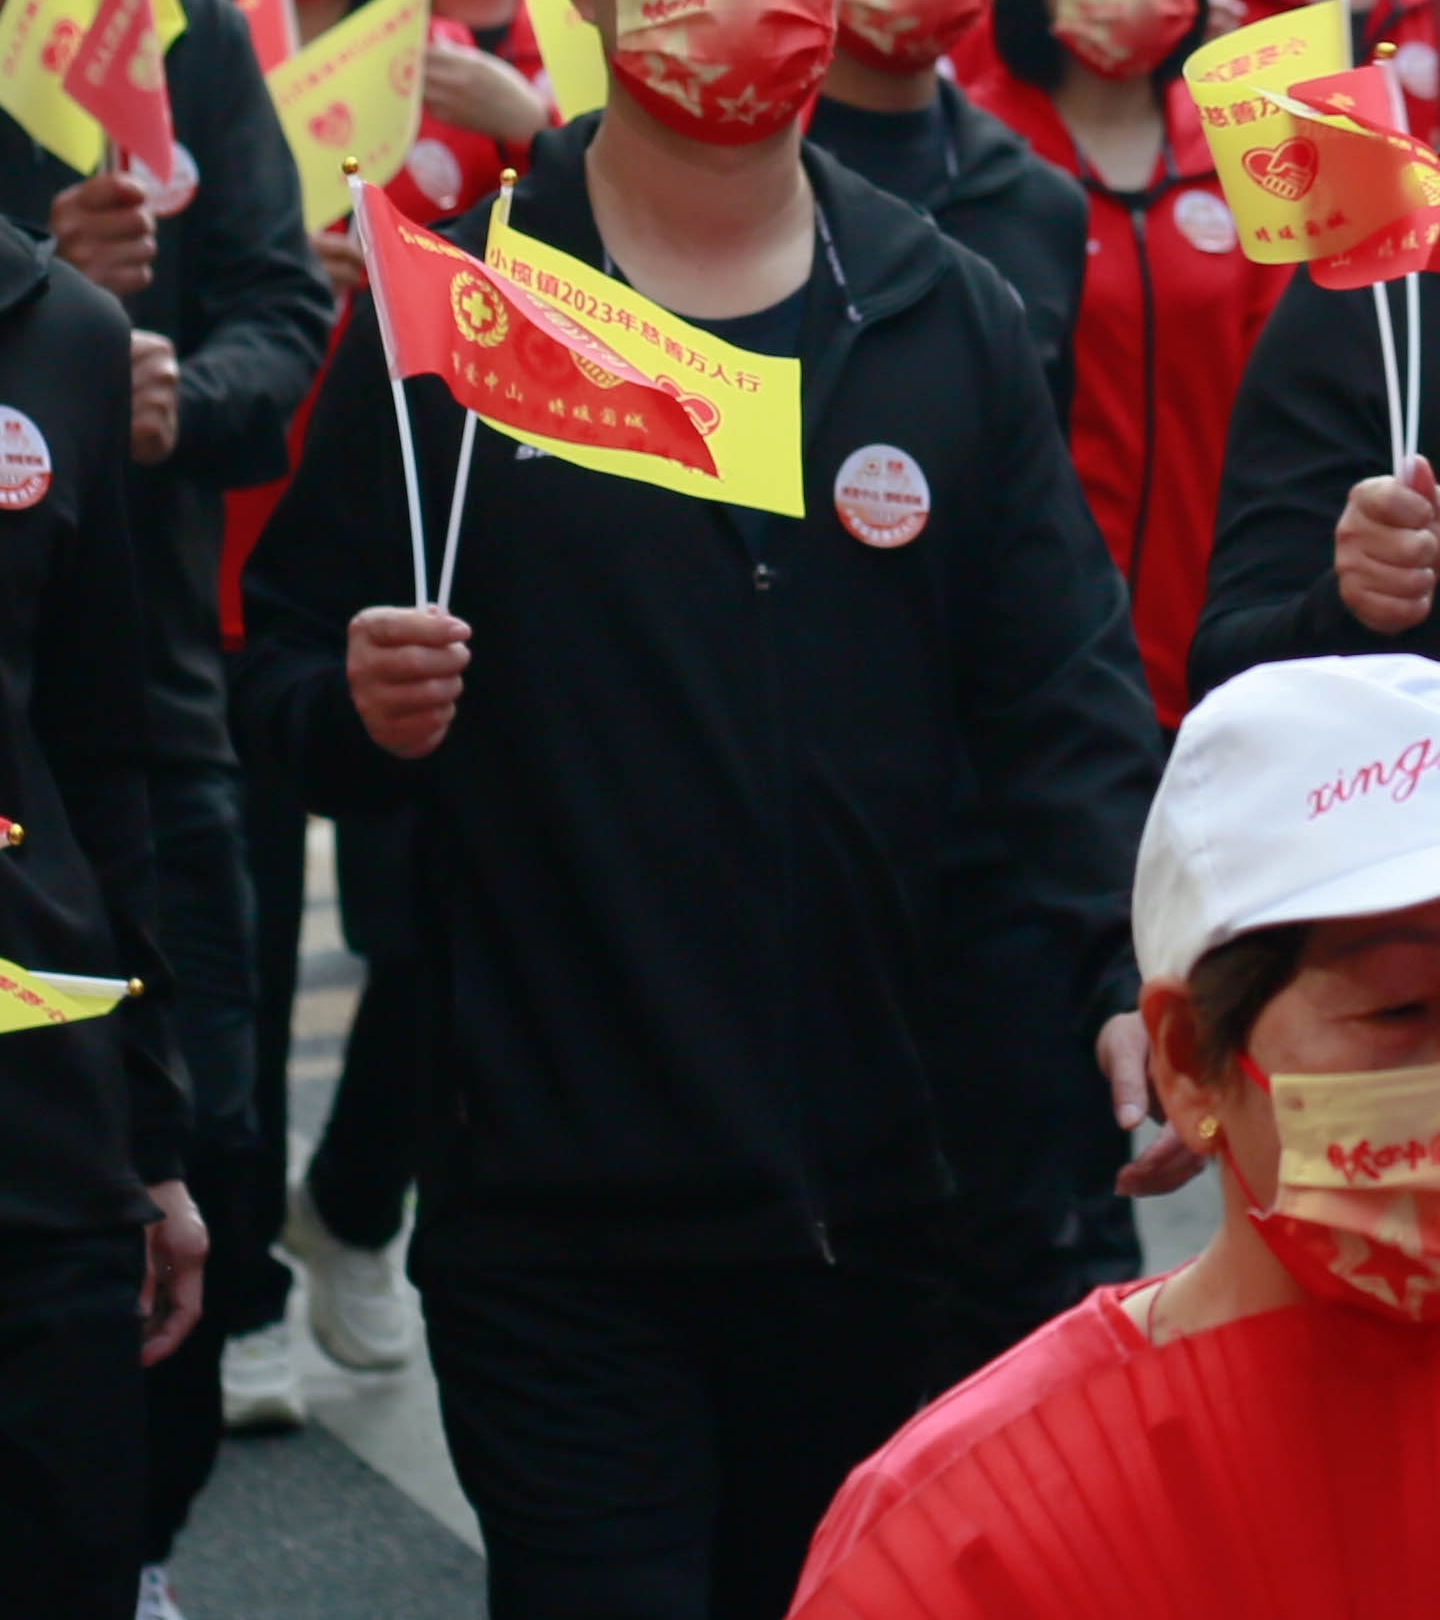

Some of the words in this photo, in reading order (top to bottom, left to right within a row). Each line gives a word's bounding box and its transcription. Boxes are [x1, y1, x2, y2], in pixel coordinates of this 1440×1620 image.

[489, 247, 762, 394] 小榄镇2023年慈善万人行
